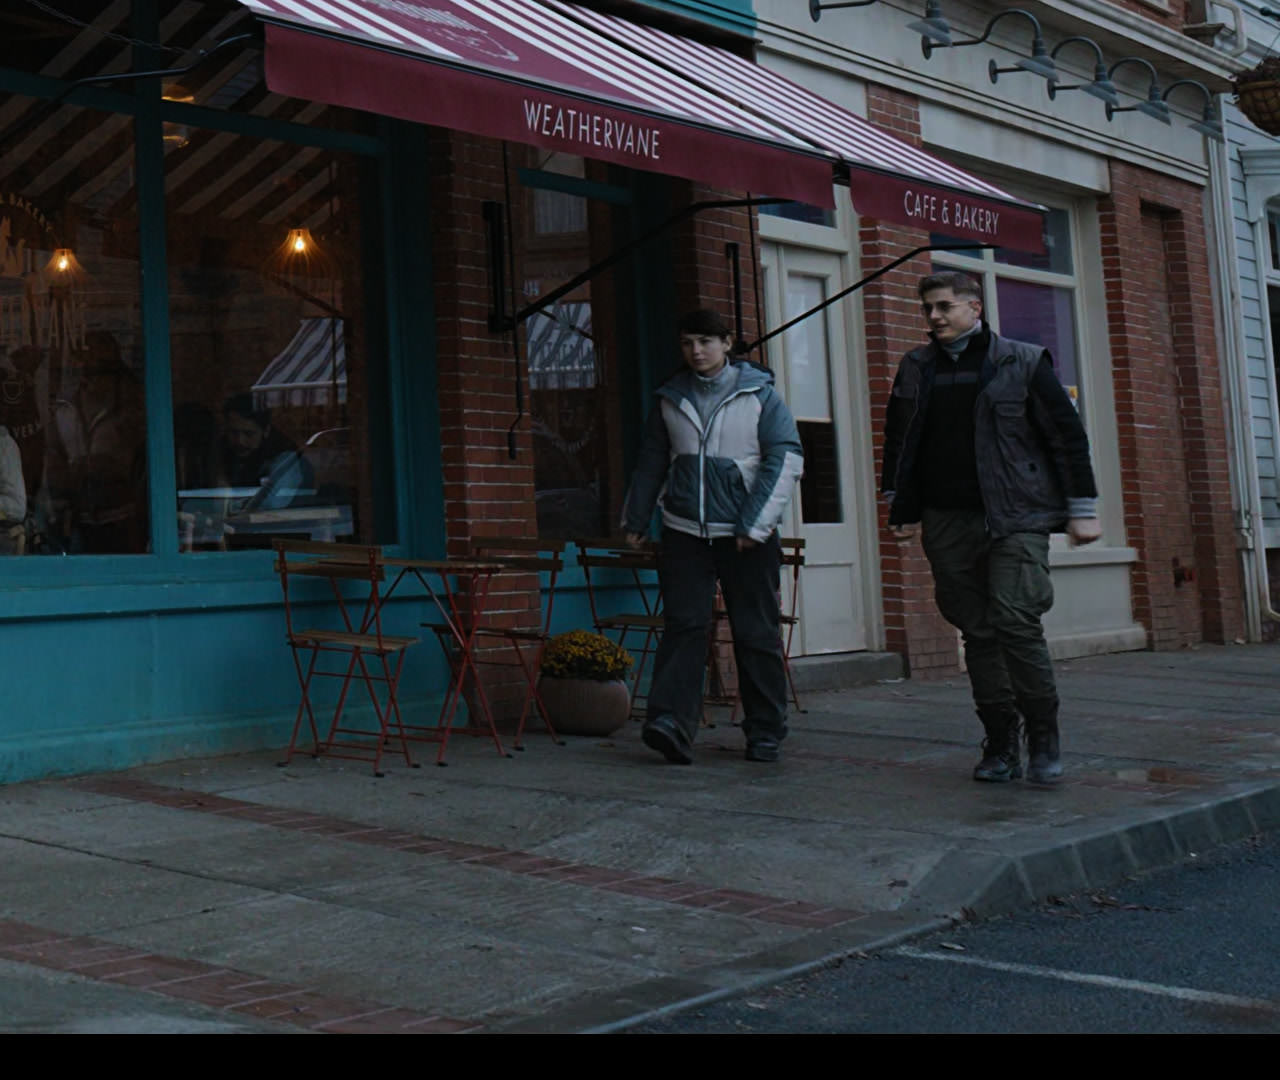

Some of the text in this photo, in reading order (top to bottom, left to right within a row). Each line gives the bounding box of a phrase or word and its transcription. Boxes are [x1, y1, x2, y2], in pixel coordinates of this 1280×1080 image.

[523, 98, 661, 160] WEATHERVANE
[903, 189, 1000, 235] CAFE & BAKERY
